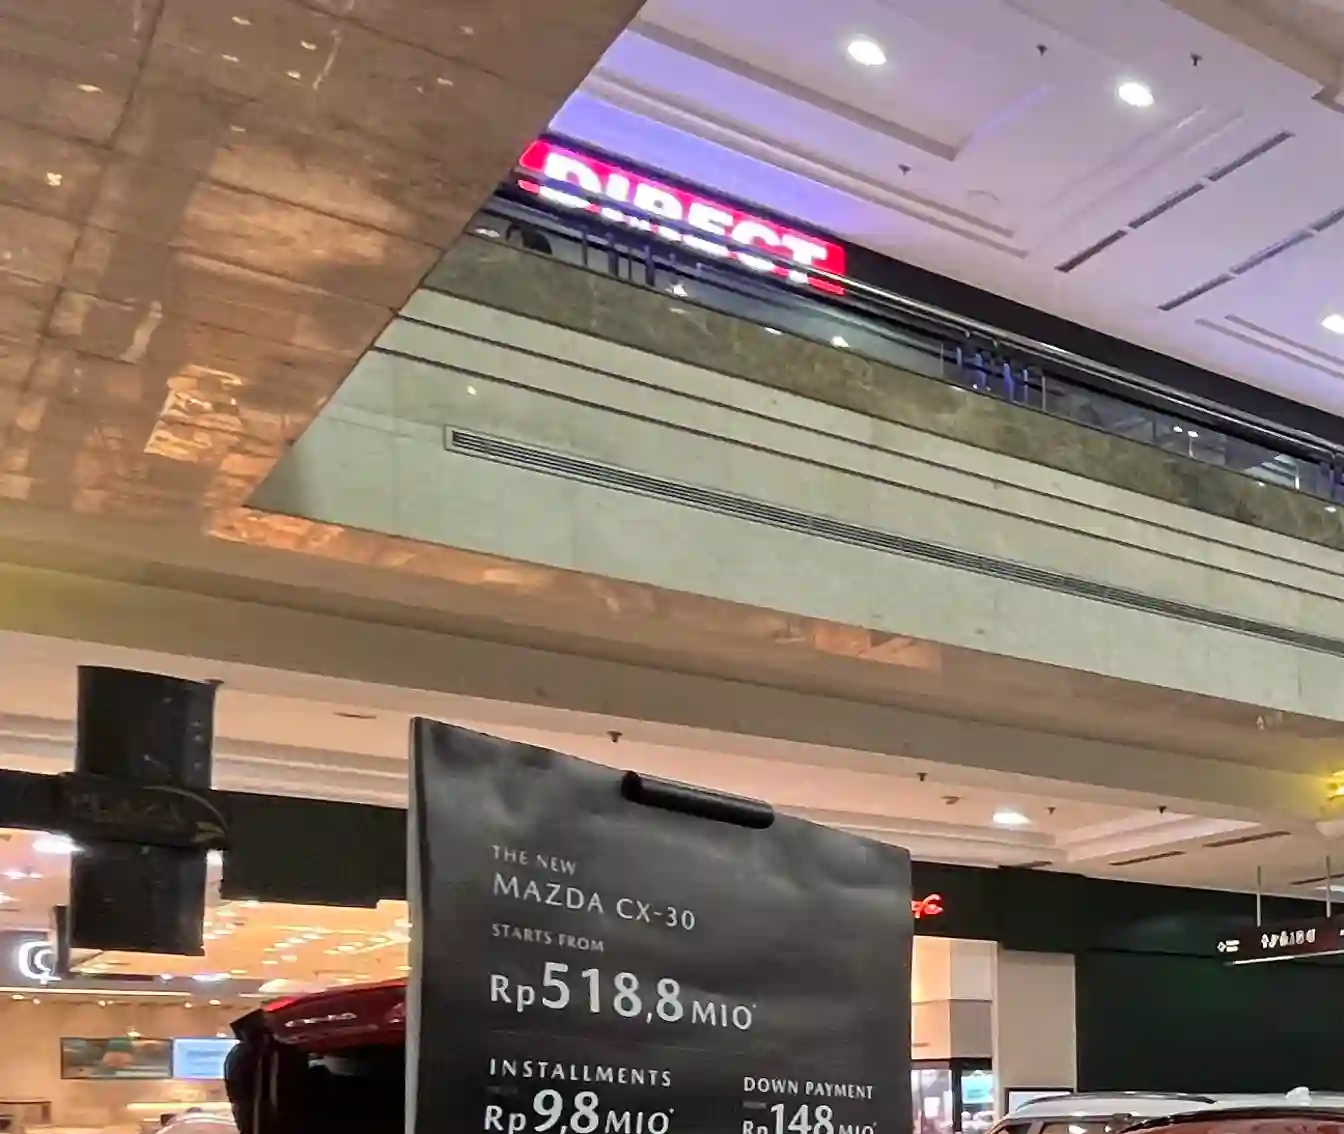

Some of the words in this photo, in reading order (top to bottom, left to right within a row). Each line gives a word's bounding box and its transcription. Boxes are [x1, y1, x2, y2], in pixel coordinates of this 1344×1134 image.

[539, 150, 828, 286] DIRECT
[491, 844, 529, 867] THE
[535, 853, 577, 877] NEW
[492, 872, 605, 916] MAZDA
[615, 896, 697, 933] CX-30
[491, 922, 553, 947] STARTS
[557, 932, 606, 954] FROM
[489, 1057, 673, 1088] INSTALLMENTS
[743, 1076, 799, 1097] DOWN
[804, 1081, 876, 1101] PAYMENT
